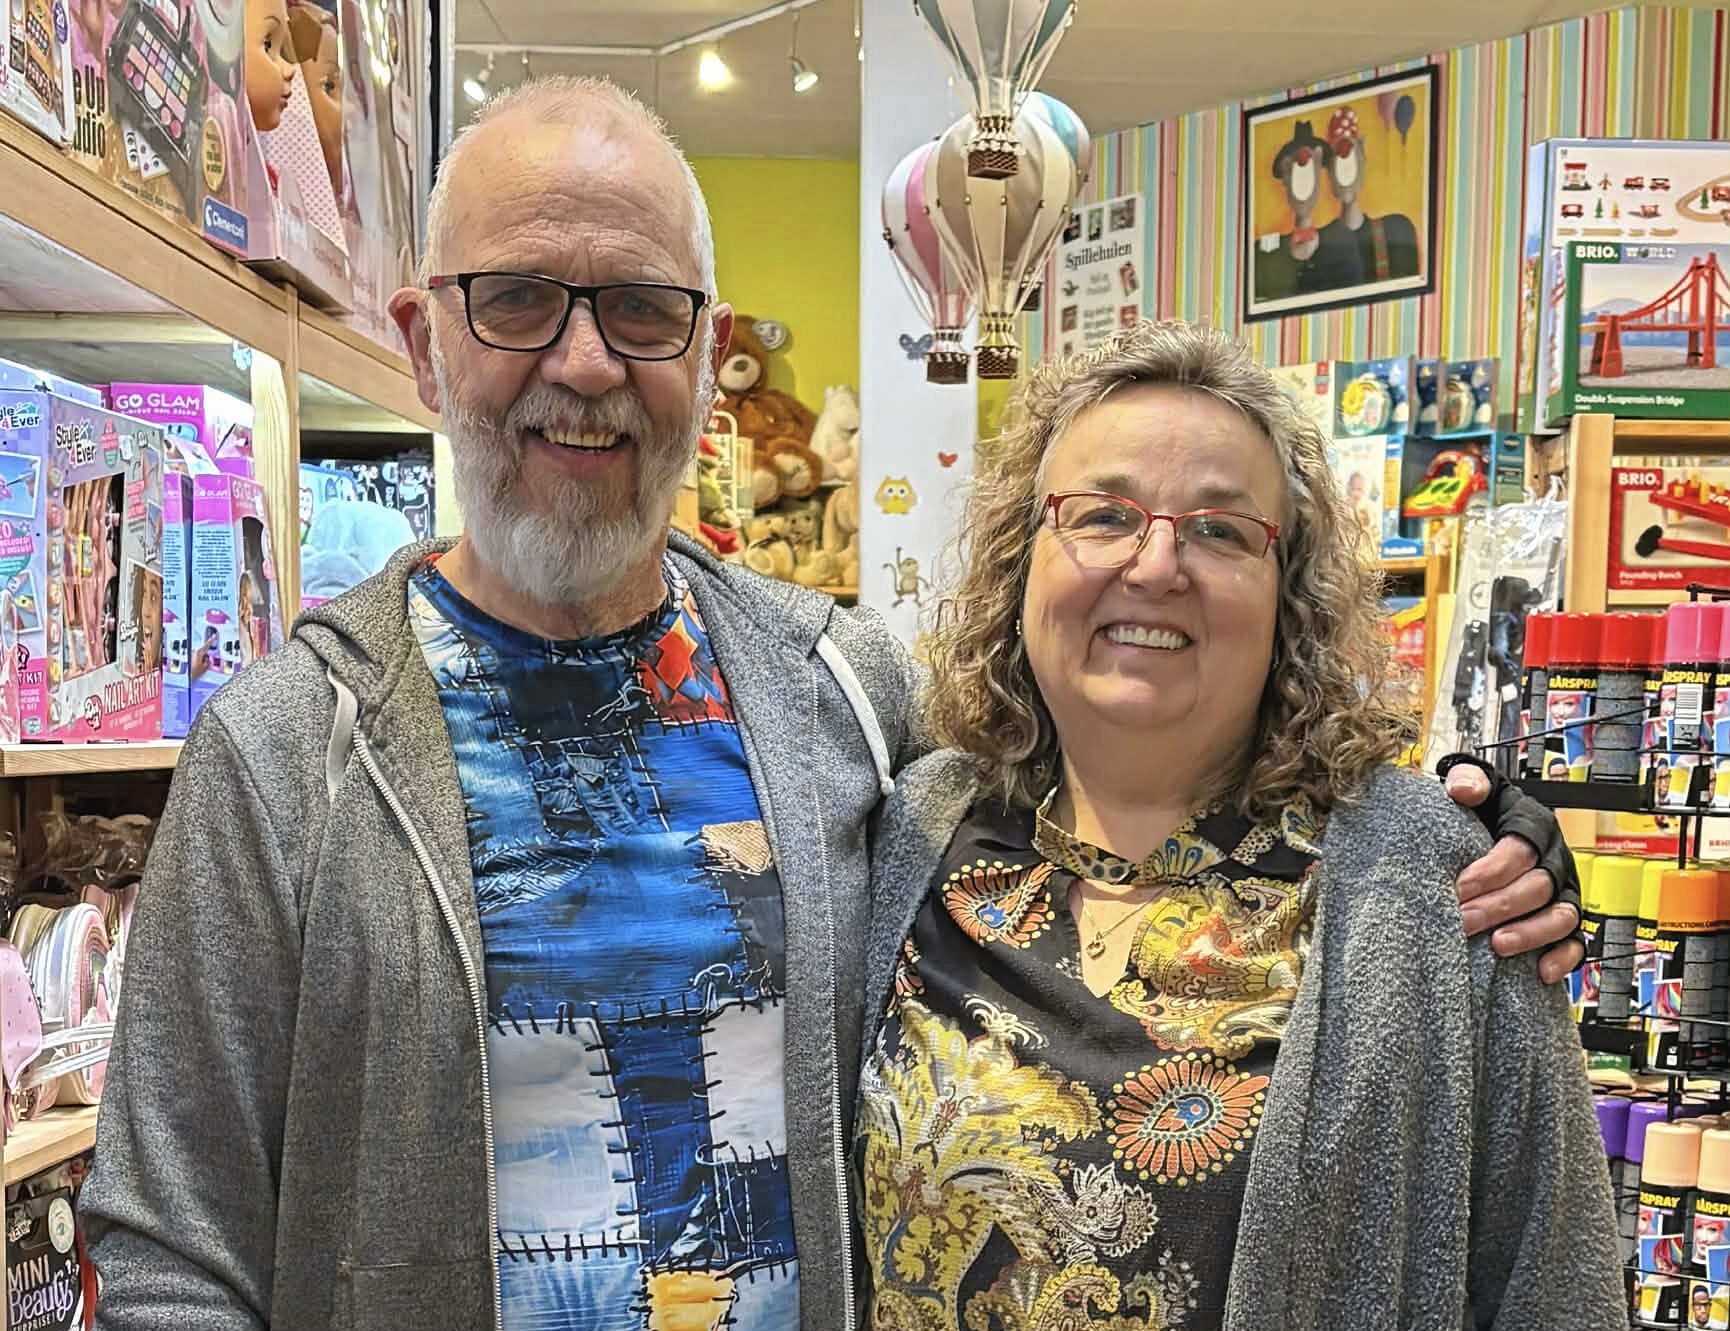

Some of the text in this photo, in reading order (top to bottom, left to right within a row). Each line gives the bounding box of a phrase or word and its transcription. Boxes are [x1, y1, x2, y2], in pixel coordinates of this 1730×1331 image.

[85, 65, 105, 117] Up
[1065, 242, 1133, 271] Spillehulen
[116, 392, 200, 411] GO GLAM
[1574, 393, 1686, 407] Double Suspension Bridge
[11, 415, 40, 428] Ever
[56, 423, 80, 450] Style
[76, 443, 96, 464] Ever
[1619, 570, 1684, 582] Pounding Bench
[104, 670, 161, 716] NAIL ART KIT
[7, 1253, 50, 1292] MINI
[8, 1268, 74, 1326] Beauty
